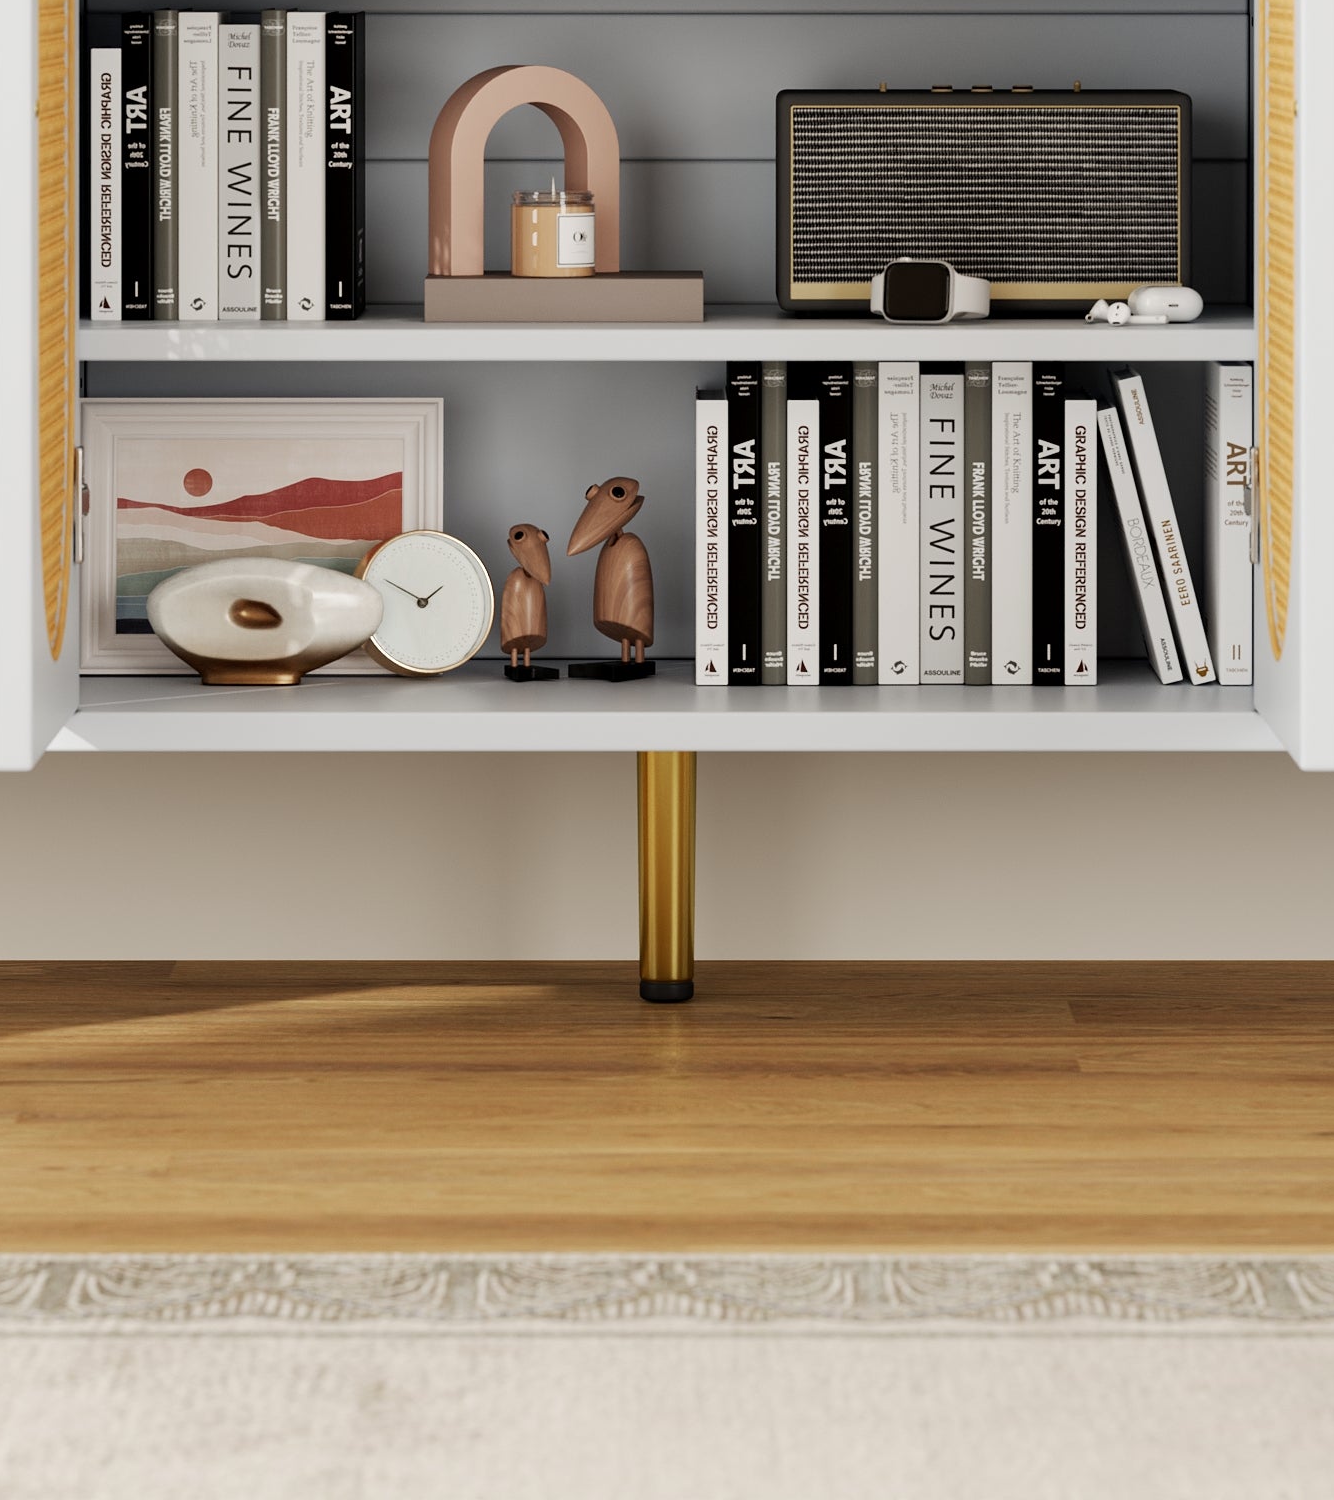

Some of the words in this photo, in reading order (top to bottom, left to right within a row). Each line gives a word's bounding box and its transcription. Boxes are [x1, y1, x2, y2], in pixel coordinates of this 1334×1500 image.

[228, 67, 251, 143] FINE
[267, 107, 280, 142] FRANK
[267, 143, 281, 178] LLOYD
[227, 162, 252, 278] WINES
[267, 178, 281, 222] WRIGHT
[1129, 387, 1145, 426] ASSOULINE
[930, 419, 955, 498] FINE
[1075, 425, 1087, 485] GRAPHIC
[972, 462, 985, 498] FRANK
[972, 499, 986, 536] LLOYD
[1075, 489, 1087, 538] DESIGN
[971, 536, 986, 581] WRIGHT
[1127, 518, 1155, 589] BORDEAUX
[1161, 519, 1183, 576] SAARINEN
[929, 519, 955, 640] WINES
[1075, 542, 1087, 630] REFERENCED
[1174, 577, 1191, 607] EERO
[923, 669, 962, 677] ASSOULINE
[1159, 636, 1174, 672] ASSOULINE
